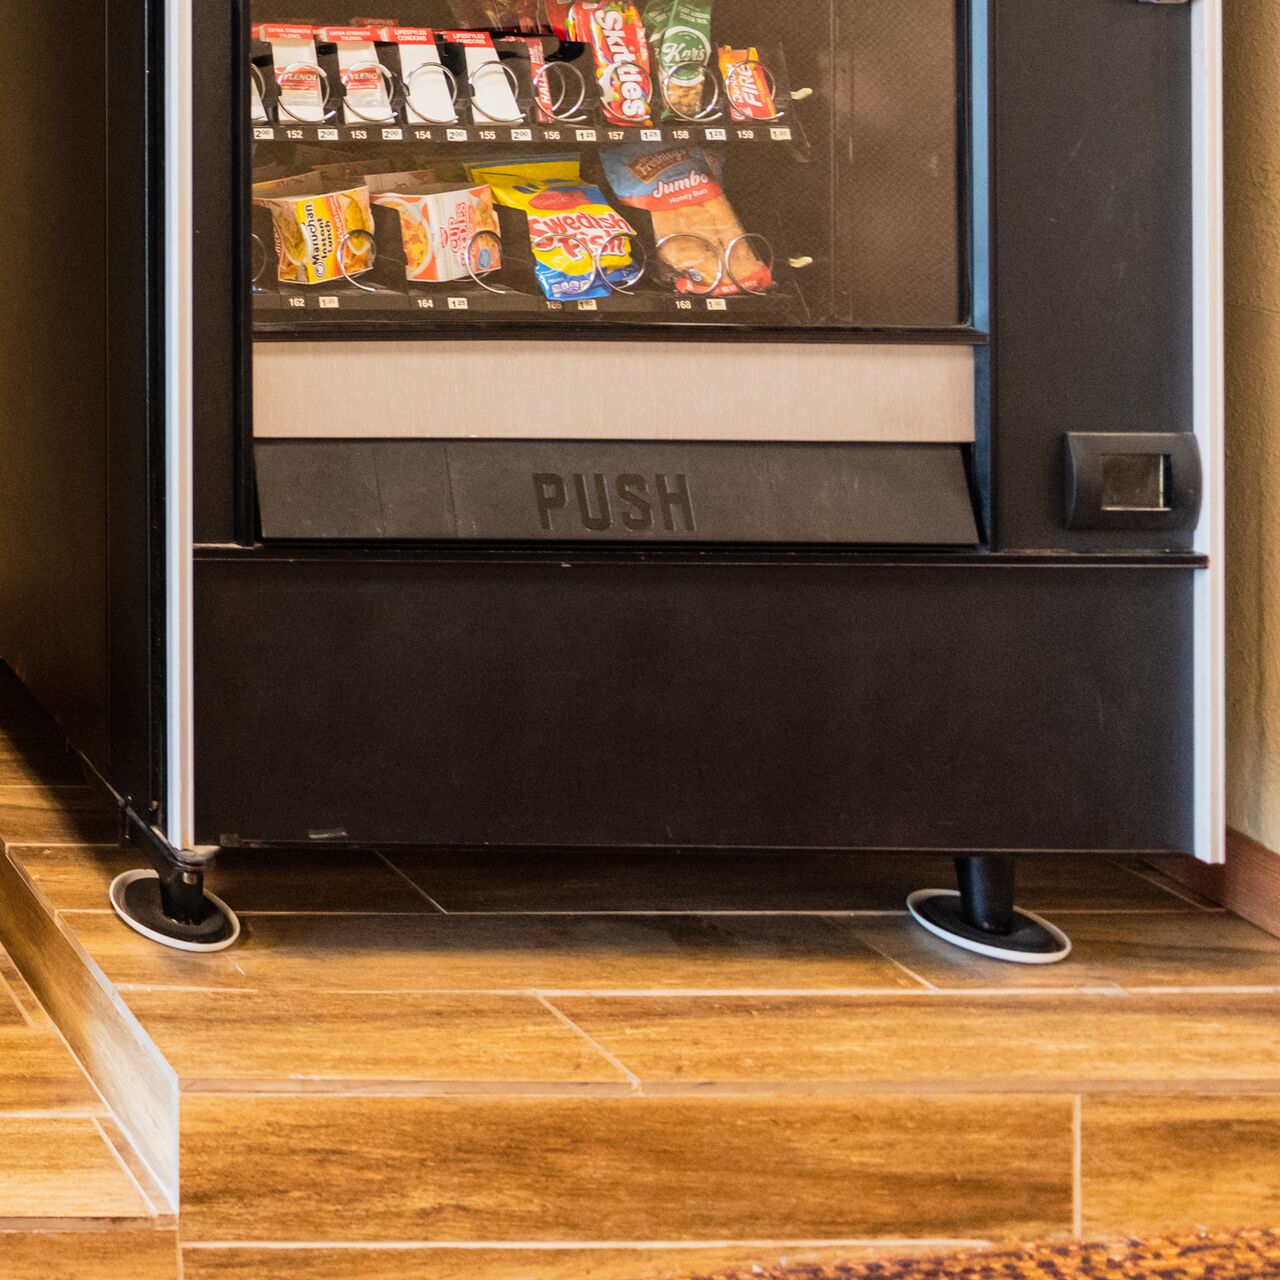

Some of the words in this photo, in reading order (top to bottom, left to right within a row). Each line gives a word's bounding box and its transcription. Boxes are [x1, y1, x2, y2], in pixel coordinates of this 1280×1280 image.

[393, 28, 428, 37] LIFESTYLES
[396, 34, 428, 42] CONDOMS
[452, 33, 485, 41] LIFESTYLES
[595, 9, 646, 116] Skittles
[286, 130, 303, 139] 152
[350, 130, 367, 139] 153
[414, 130, 431, 139] 154
[479, 130, 496, 139] 155
[543, 131, 560, 140] 156
[608, 131, 624, 139] 157
[672, 131, 689, 139] 158
[736, 130, 754, 139] 159
[653, 170, 709, 198] Jumbo
[668, 194, 692, 204] Honey
[692, 188, 708, 197] Bun
[304, 203, 320, 266] Maruchan
[316, 217, 328, 260] Instant
[326, 220, 334, 253] Lunch
[529, 211, 636, 239] Swedish
[558, 230, 627, 261] Fish
[288, 298, 305, 307] 162
[417, 298, 433, 308] 164
[675, 300, 691, 309] 168
[532, 472, 697, 532] PUSH
